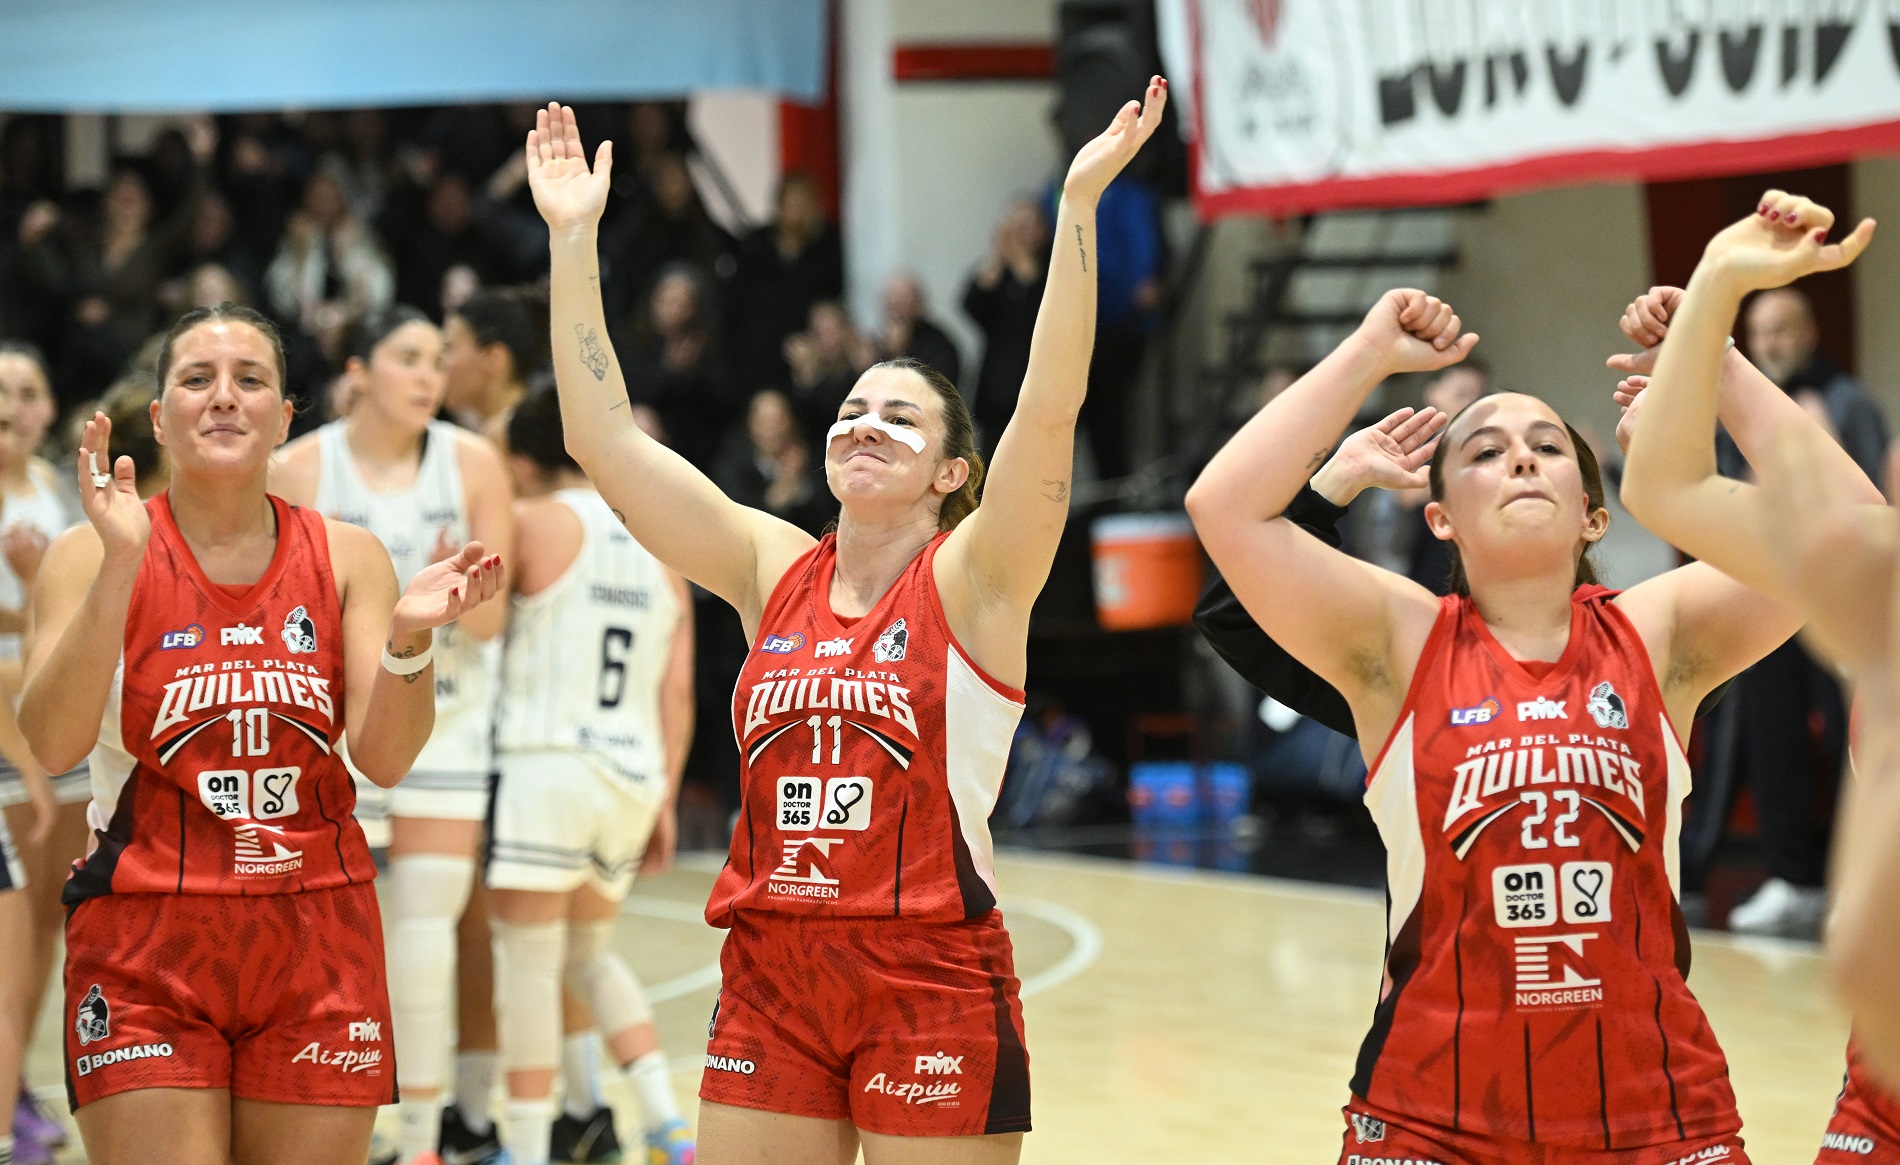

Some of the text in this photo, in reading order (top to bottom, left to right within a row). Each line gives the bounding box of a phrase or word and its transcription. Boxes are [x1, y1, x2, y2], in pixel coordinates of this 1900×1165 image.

[163, 632, 196, 648] LFB
[761, 636, 793, 653] LFB
[175, 659, 319, 678] MAR DEL PLATA
[599, 626, 632, 710] 6
[762, 667, 900, 682] MAR DEL PLATA
[150, 671, 334, 741] QUILMES
[743, 677, 920, 742] QUILMES
[1451, 708, 1491, 725] LFB
[225, 707, 270, 757] 10
[806, 715, 842, 764] 11
[1466, 734, 1632, 758] MAR DEL PLATA
[208, 776, 239, 793] on
[783, 782, 812, 799] on
[1442, 746, 1646, 833] QUILMES
[213, 802, 242, 816] 365
[782, 810, 810, 825] 365
[1520, 789, 1581, 849] 22
[234, 858, 303, 875] NORGREEN
[768, 882, 839, 899] NORGREEN
[1504, 871, 1543, 892] on
[1506, 893, 1544, 902] DOCTOR
[1507, 903, 1546, 921] 365
[1515, 988, 1603, 1006] NORGREEN
[91, 1043, 173, 1069] BONANO
[704, 1054, 756, 1075] ONANO
[864, 1072, 961, 1105] Aizpún
